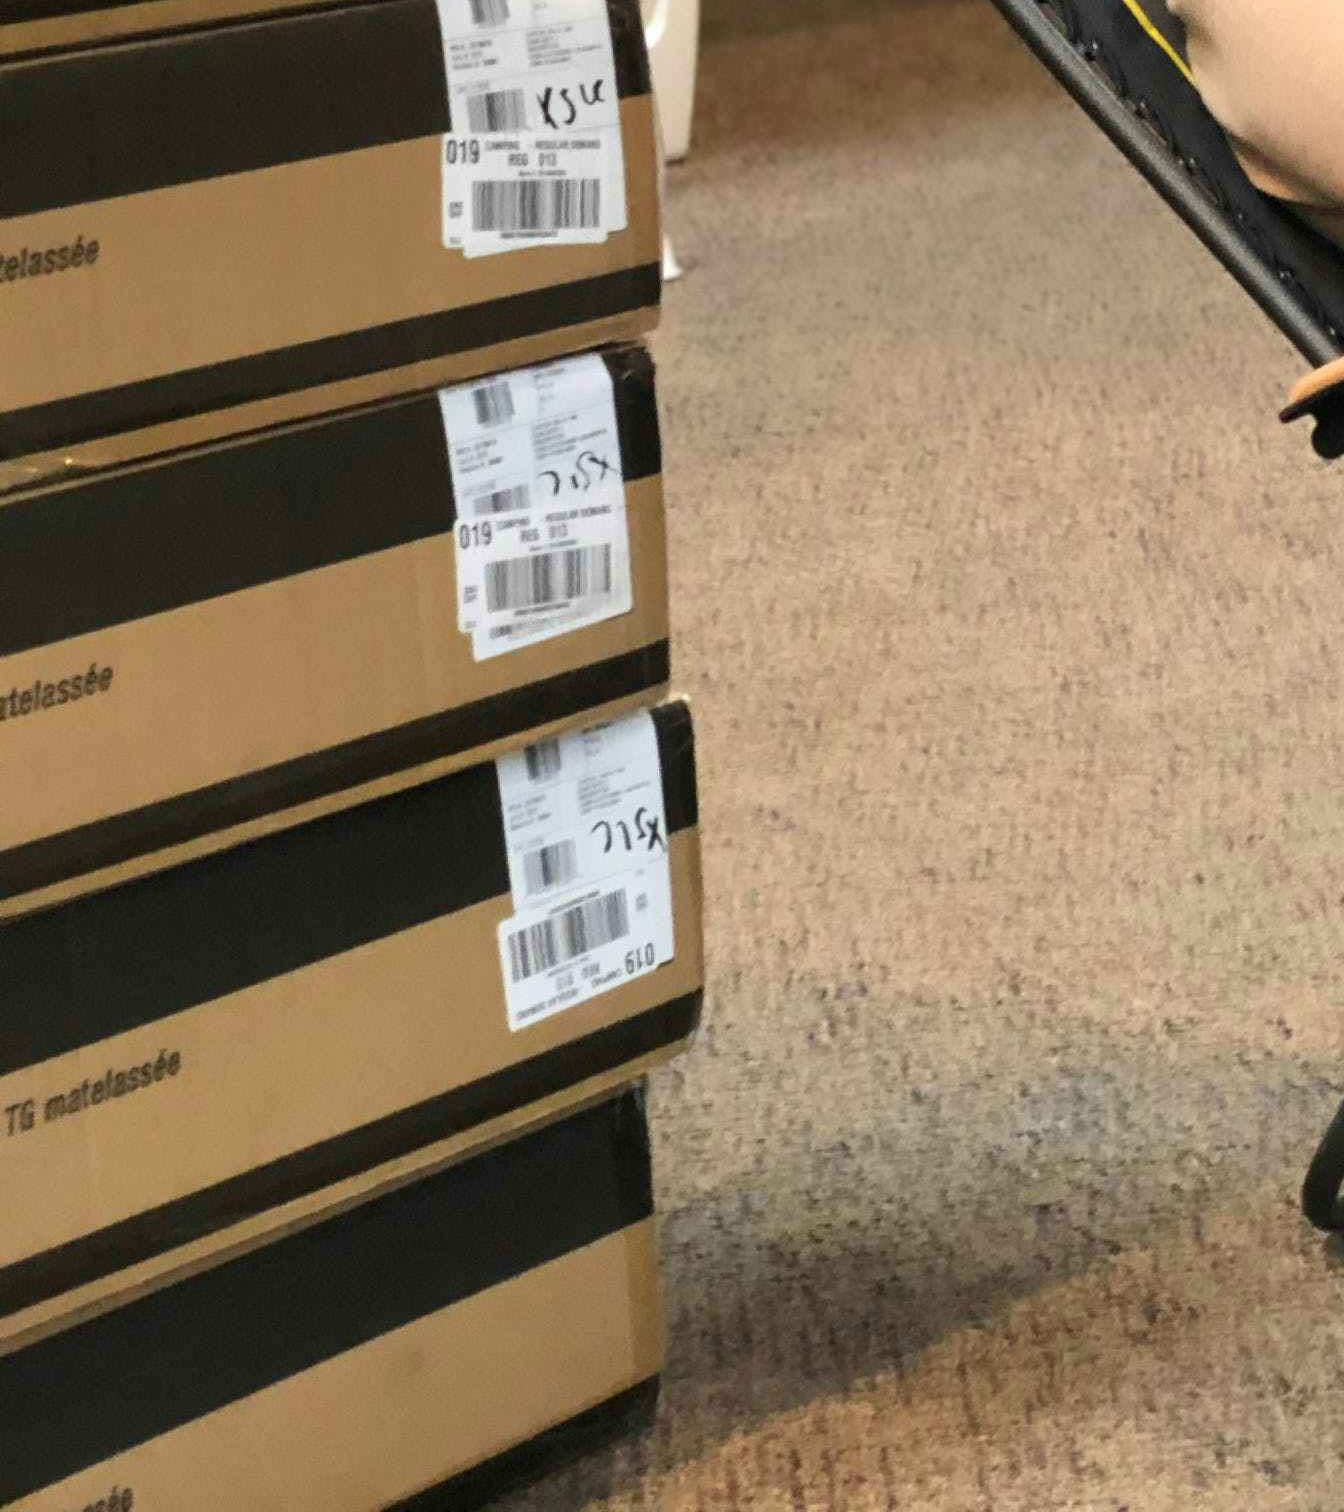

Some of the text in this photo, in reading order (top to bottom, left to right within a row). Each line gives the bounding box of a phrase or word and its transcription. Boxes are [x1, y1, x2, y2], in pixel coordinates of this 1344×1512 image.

[446, 139, 480, 165] 019
[459, 521, 492, 550] 019
[5, 1048, 181, 1136] TG matelassée
